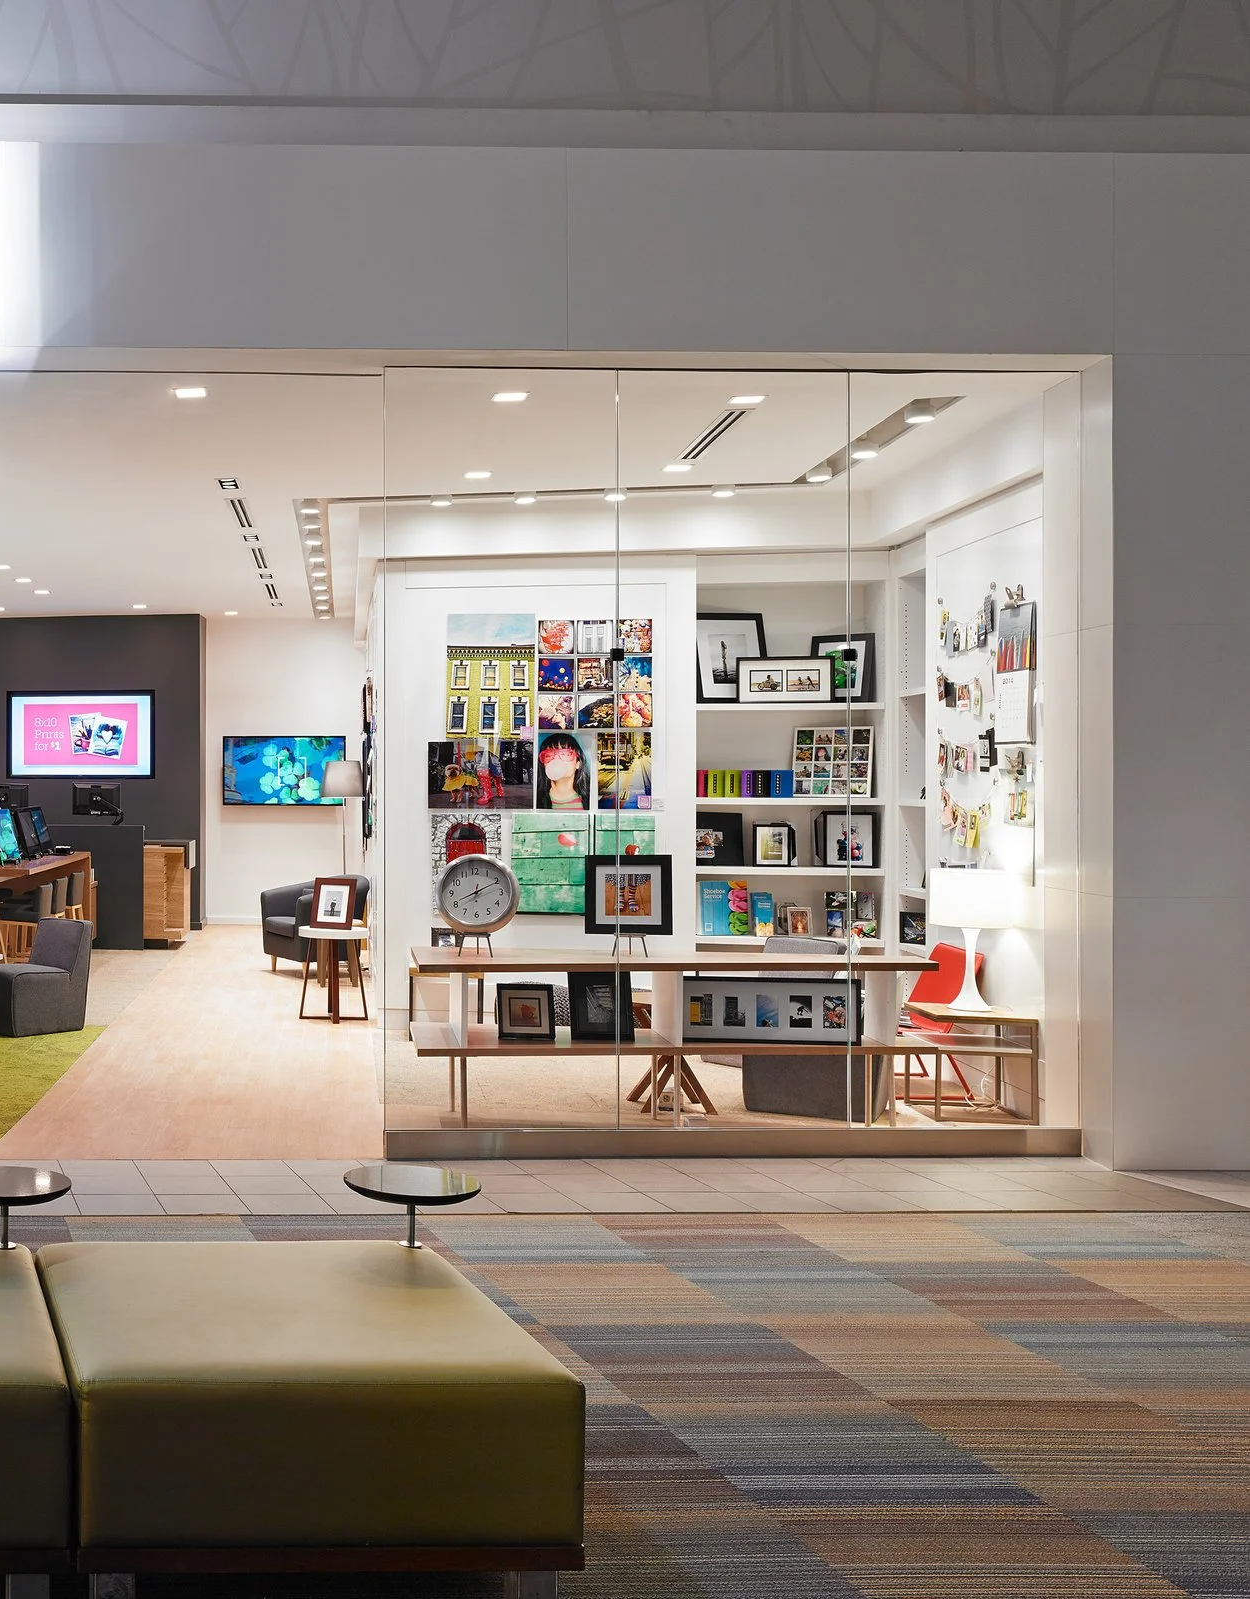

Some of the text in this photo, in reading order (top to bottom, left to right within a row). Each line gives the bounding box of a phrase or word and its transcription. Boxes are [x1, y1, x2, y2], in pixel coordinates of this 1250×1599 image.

[34, 717, 58, 728] 8x10
[34, 730, 65, 739] Prints
[34, 741, 62, 751] for $1
[461, 871, 468, 879] 11
[471, 867, 479, 876] 12
[452, 879, 461, 887] 10
[494, 876, 500, 885] 2
[448, 889, 455, 897] 9
[499, 888, 504, 896] 3
[453, 900, 459, 908] 8
[494, 899, 500, 907] 4
[462, 908, 468, 916] 7
[474, 910, 480, 919] 6
[486, 907, 492, 916] 5
